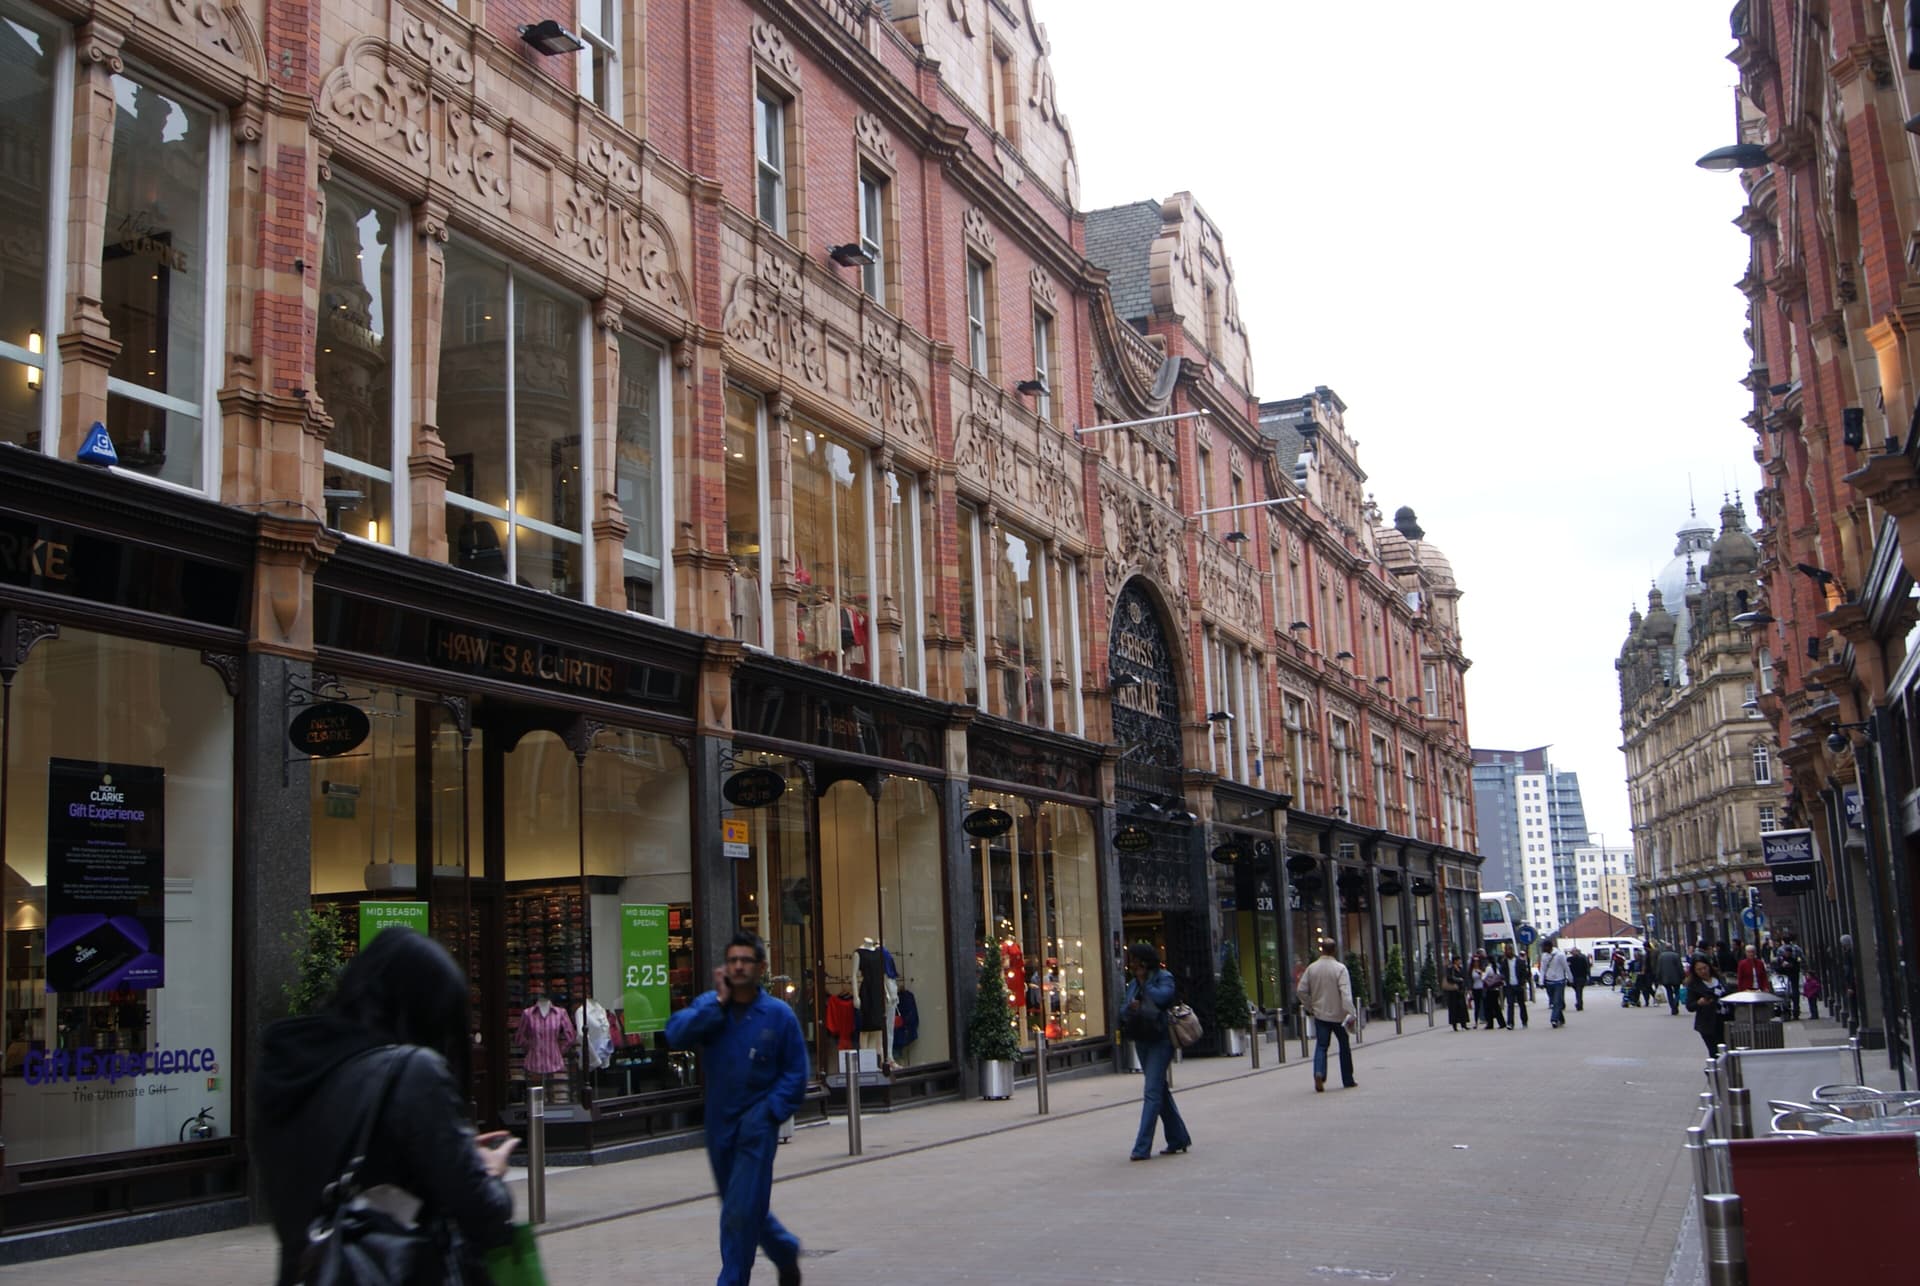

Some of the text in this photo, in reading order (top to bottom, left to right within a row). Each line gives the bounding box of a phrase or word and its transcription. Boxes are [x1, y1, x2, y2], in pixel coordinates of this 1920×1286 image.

[1119, 631, 1154, 669] CROSS
[439, 632, 615, 692] HAWES & CURTIS
[90, 791, 125, 803] CLARKE
[69, 803, 146, 821] Gift Experience
[1766, 843, 1809, 854] HALIFAX
[1775, 874, 1810, 882] Rohan
[366, 907, 423, 917] MID SEASON
[626, 909, 665, 917] MID SEASON
[633, 919, 659, 927] SPECIAL
[626, 964, 668, 988] £25
[24, 1042, 216, 1086] Gift Experience
[71, 1083, 168, 1104] The Ultimate Gift
